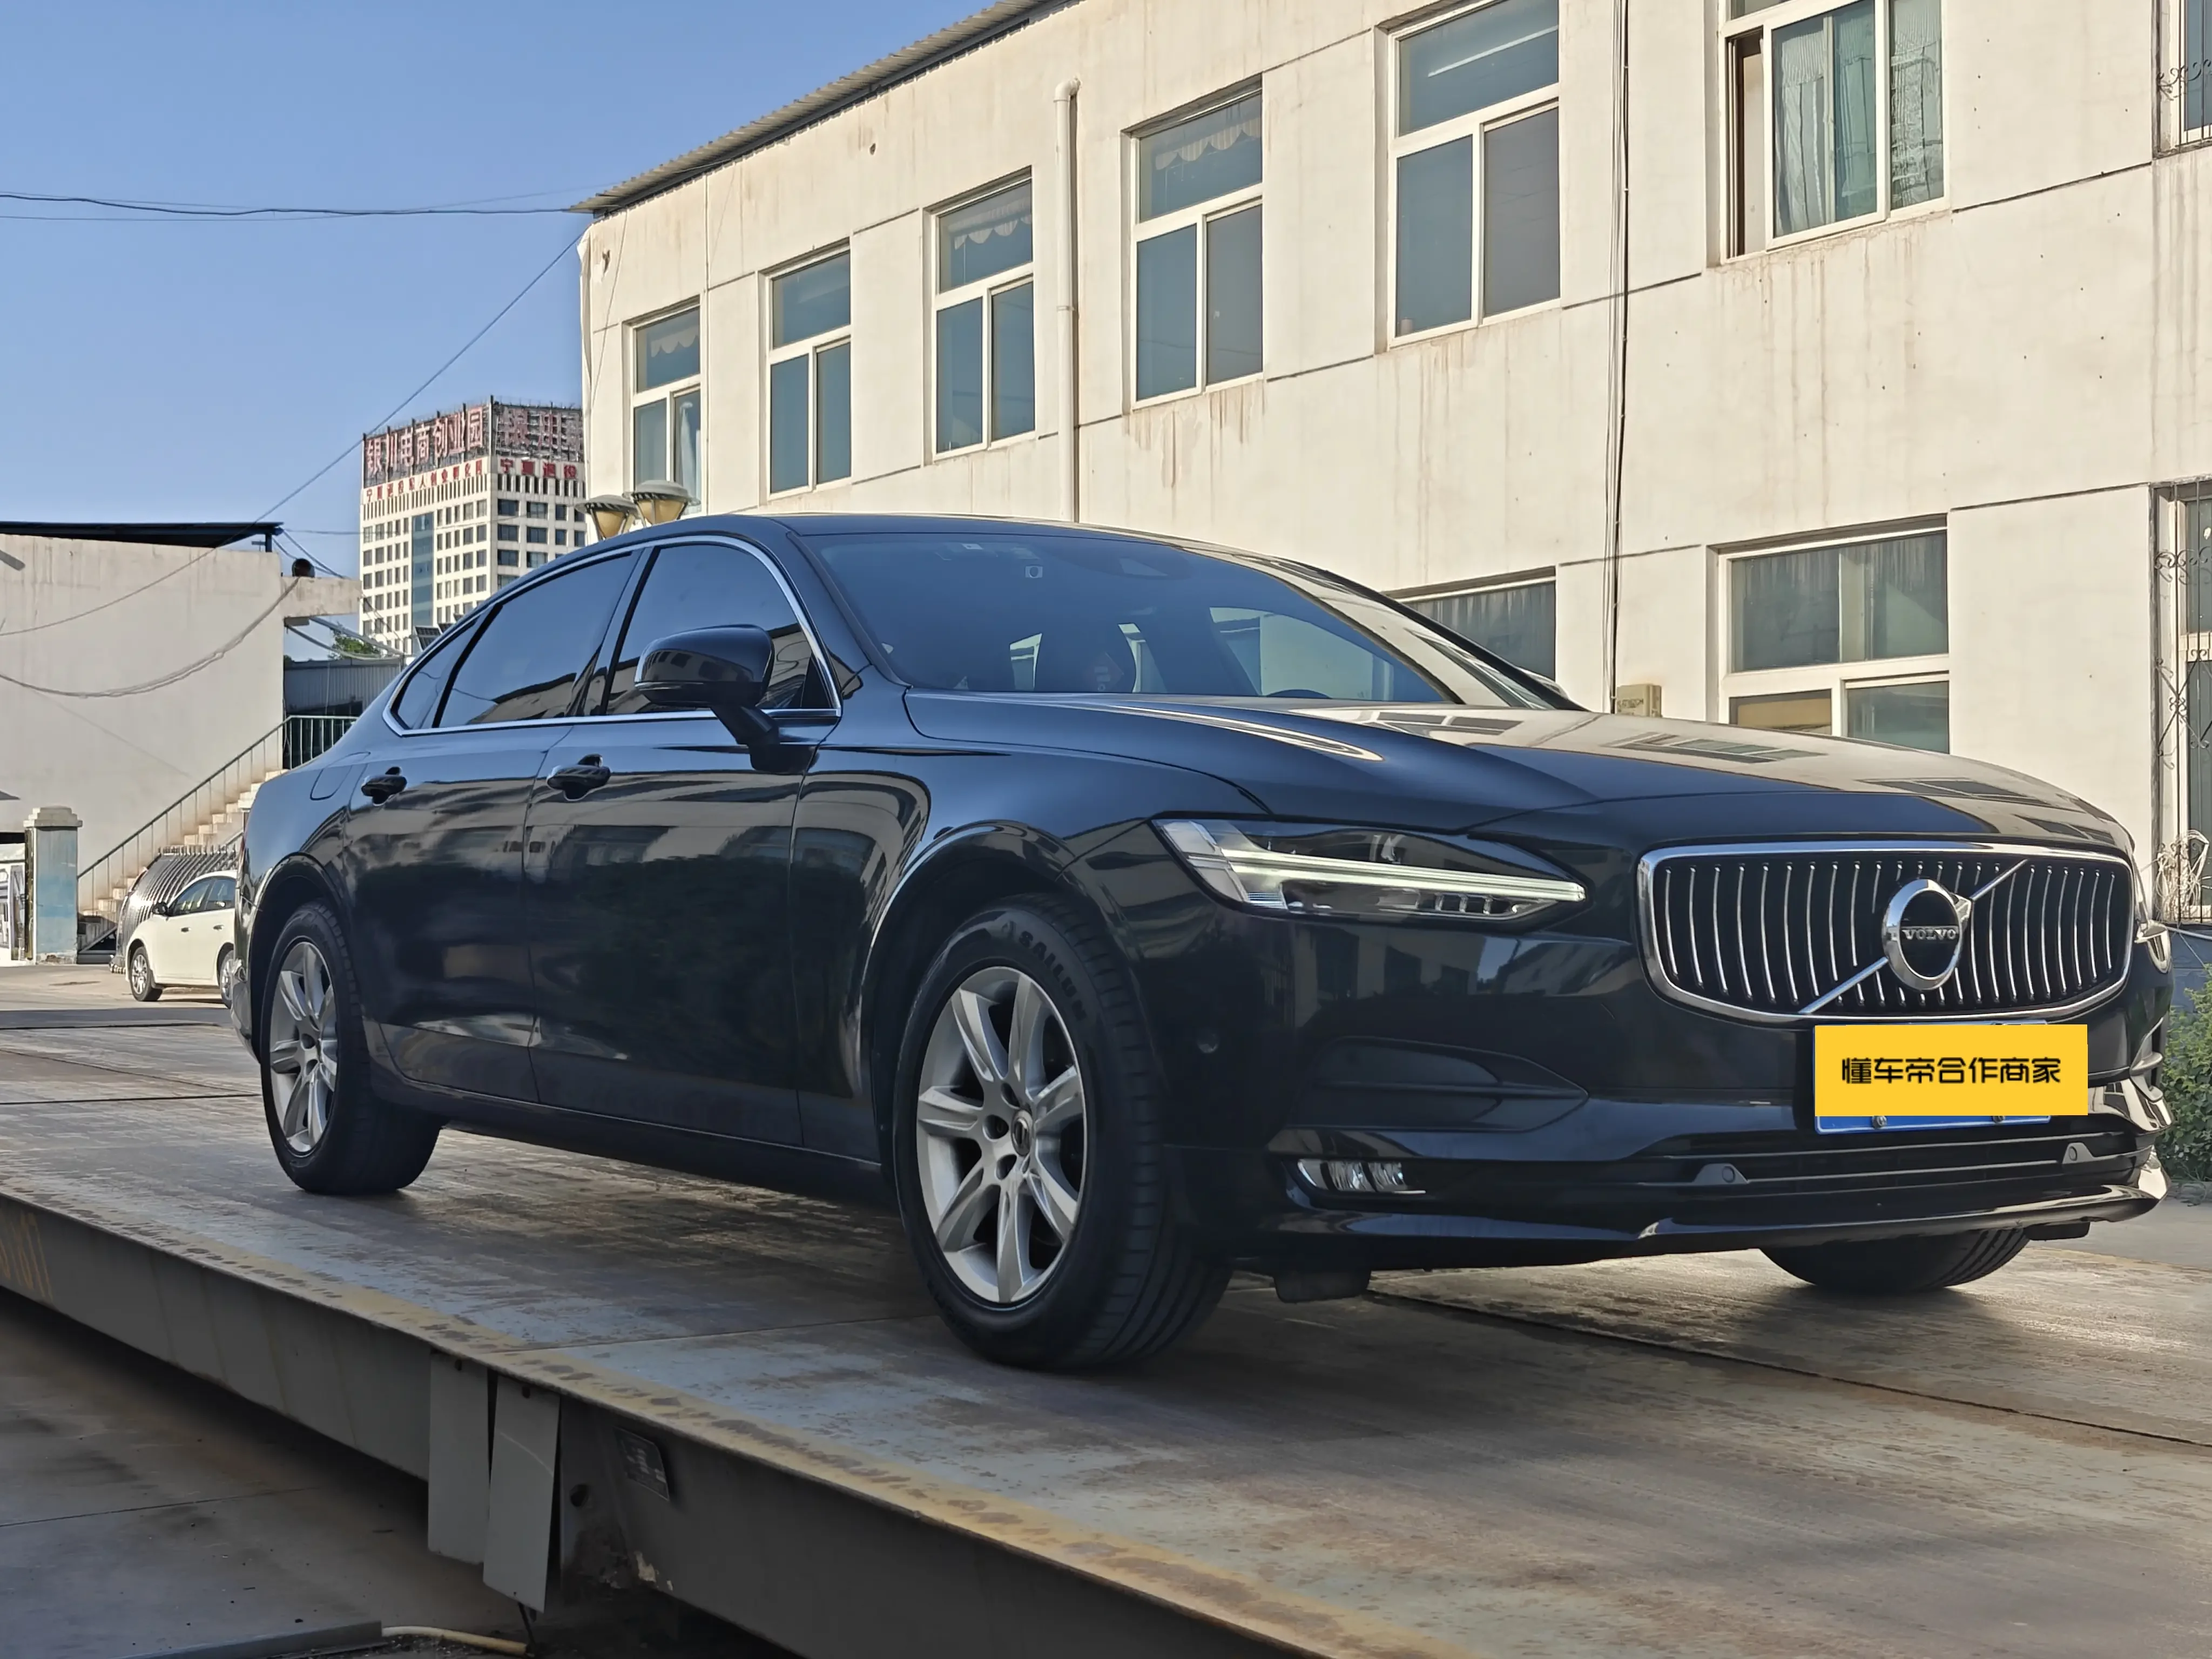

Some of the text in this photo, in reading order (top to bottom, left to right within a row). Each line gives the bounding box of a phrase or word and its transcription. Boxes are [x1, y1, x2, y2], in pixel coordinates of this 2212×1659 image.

[366, 407, 483, 475] 银川电商创业园
[1901, 929, 1956, 940] VOLVO
